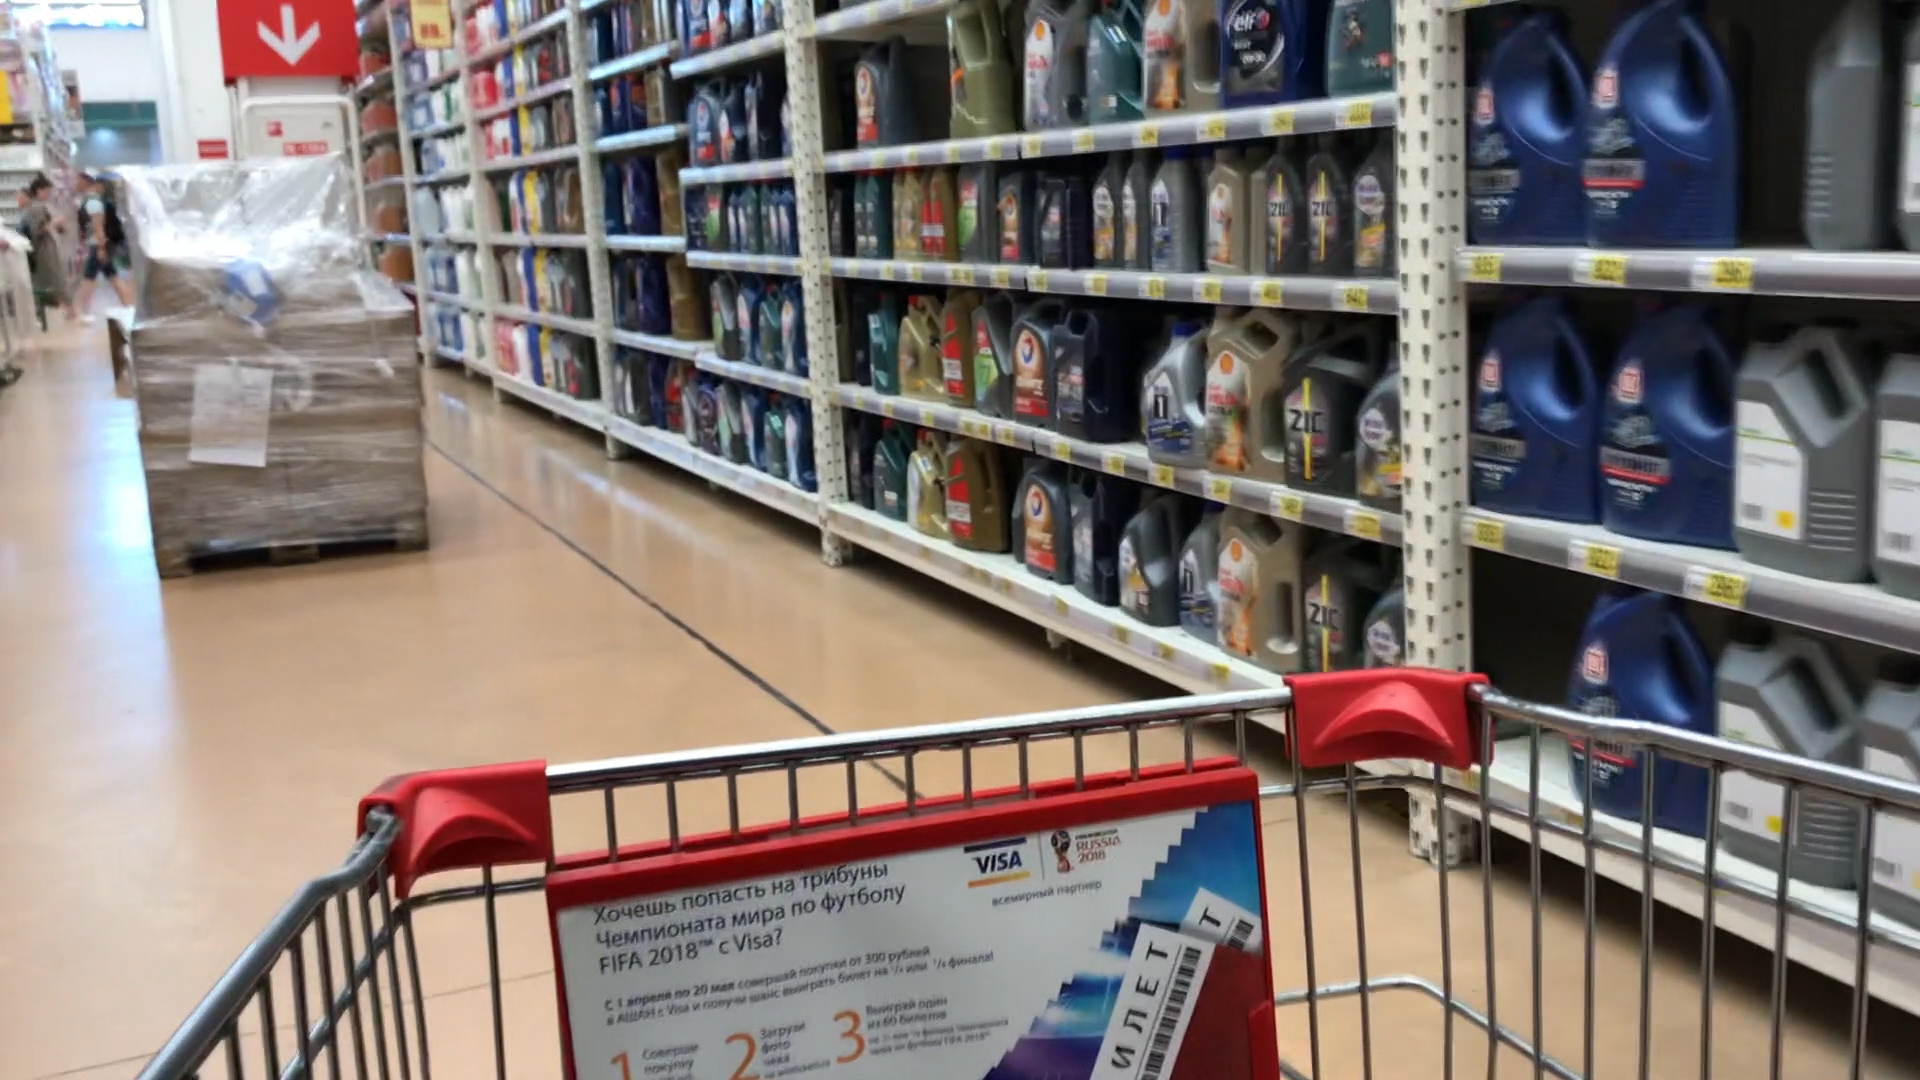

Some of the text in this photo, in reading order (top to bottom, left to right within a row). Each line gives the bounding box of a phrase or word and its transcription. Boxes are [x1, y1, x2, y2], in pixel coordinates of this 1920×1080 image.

[1288, 409, 1324, 433] ZIC
[1308, 602, 1340, 630] ZIC
[1076, 836, 1121, 851] RUSSIA
[1078, 849, 1106, 864] 2018
[972, 849, 1023, 875] VISA
[593, 863, 888, 925] Хочешь попасть на трибуны
[992, 880, 1102, 906] всемирный партнер
[596, 884, 906, 948] Чемпионата мира по футболу
[600, 928, 784, 975] FIFA 2018™ с Visa?
[693, 984, 708, 995] 20
[865, 952, 886, 964] 300
[833, 1010, 865, 1065] 3
[724, 1032, 759, 1080] 2
